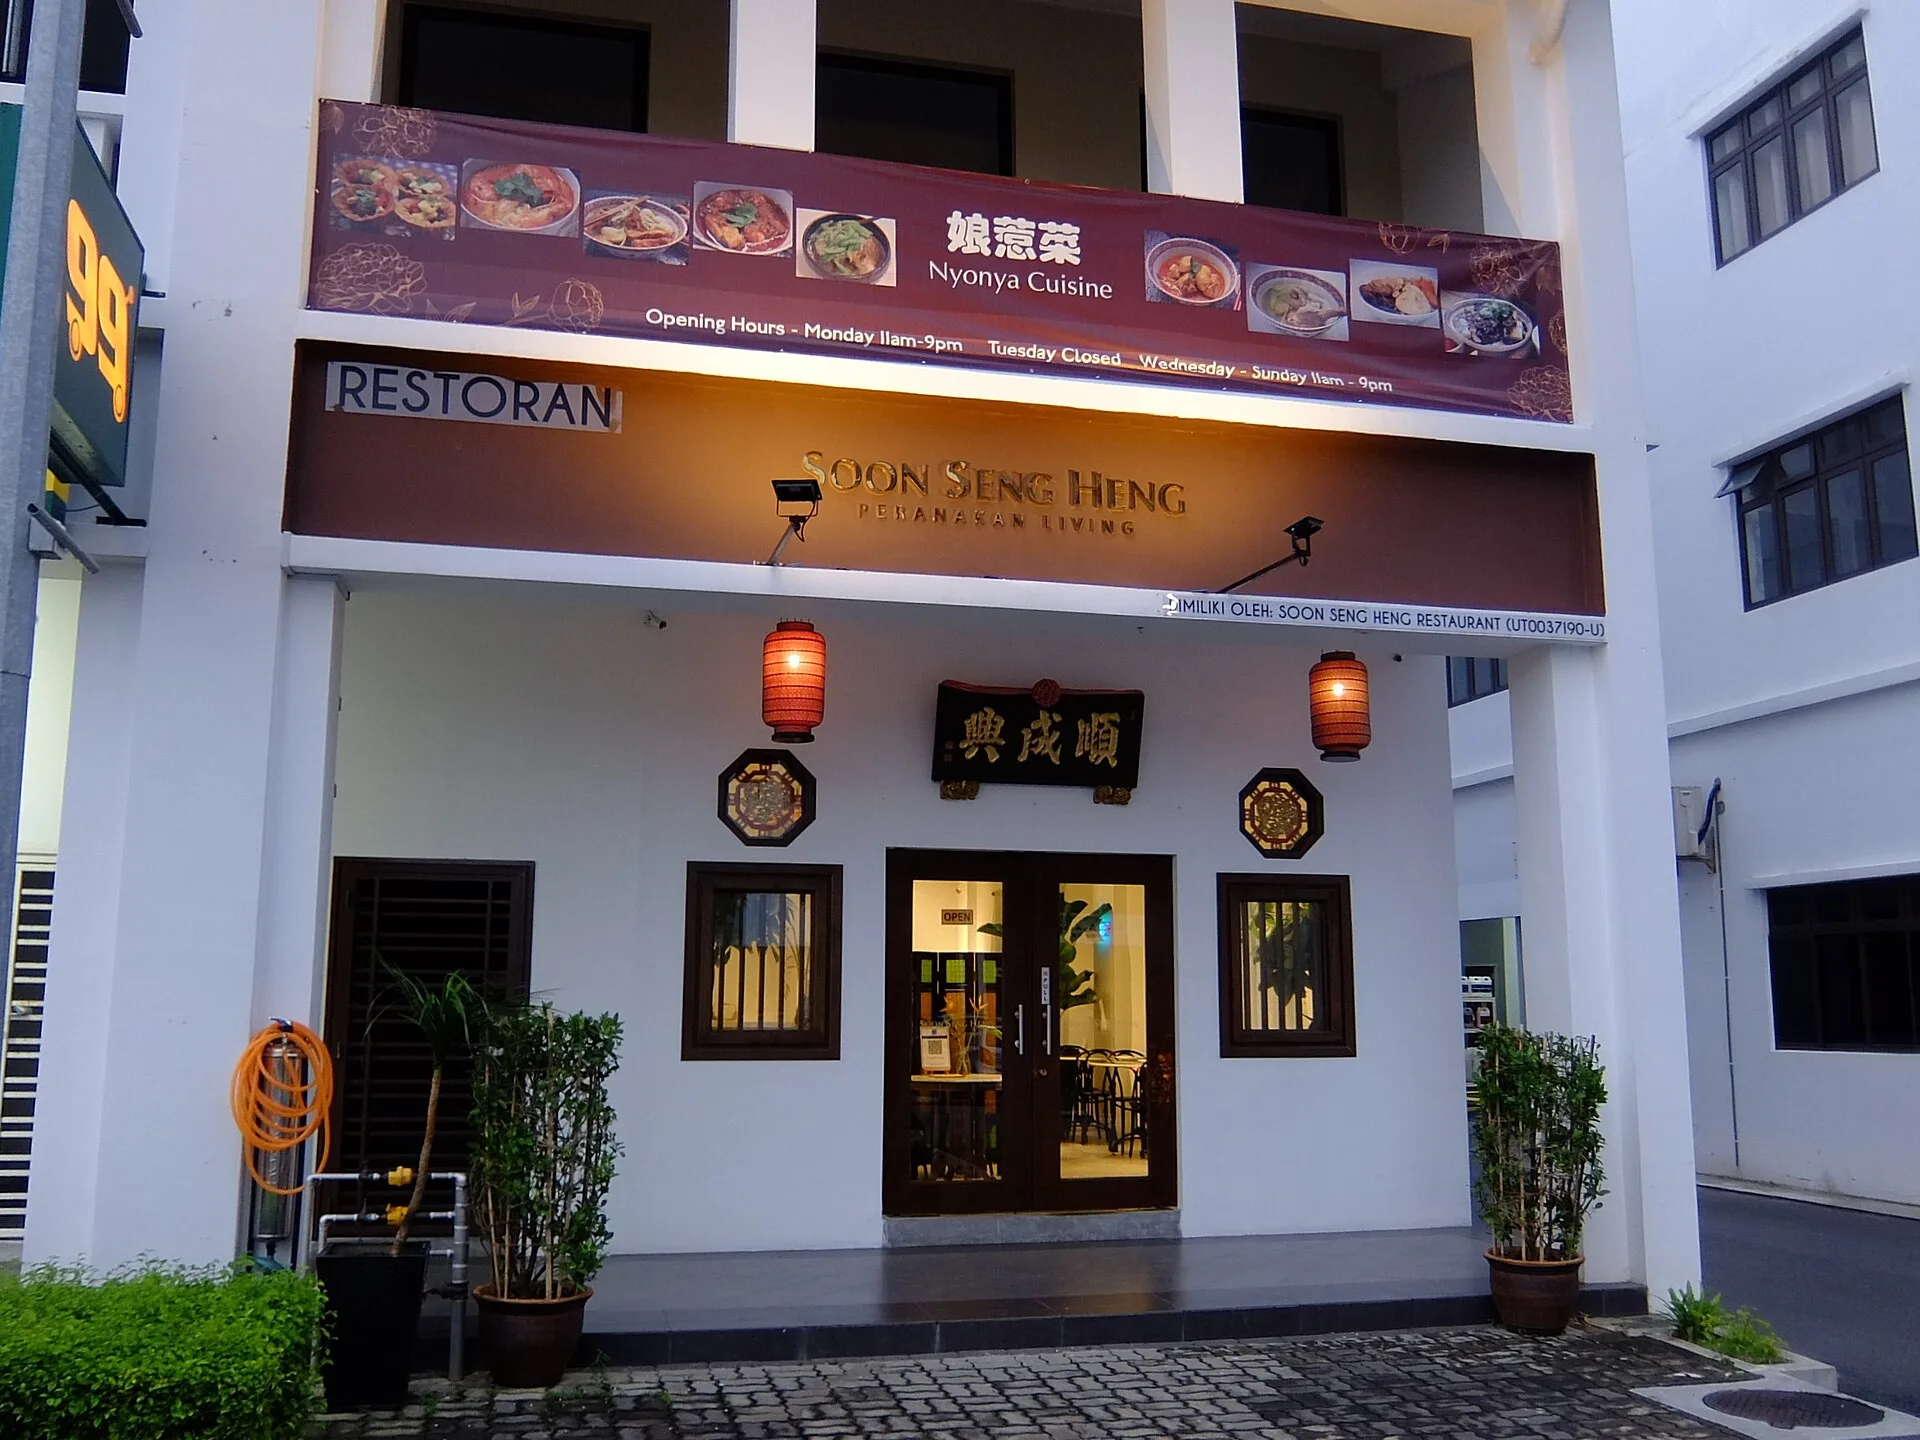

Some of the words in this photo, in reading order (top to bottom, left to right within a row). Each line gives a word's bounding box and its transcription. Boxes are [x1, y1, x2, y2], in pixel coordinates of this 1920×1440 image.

[946, 210, 1081, 266] 娘惹菜
[928, 260, 1020, 295] Nyonya
[1027, 271, 1113, 299] Cuisine
[64, 198, 131, 424] 99
[645, 308, 726, 335] Opening
[731, 316, 786, 336] Hours
[804, 322, 875, 347] Monday
[880, 330, 963, 354] 11am-9pm
[988, 340, 1056, 363] Tuesday
[1061, 347, 1122, 366] Closed
[1138, 353, 1235, 379] Wednesday
[1251, 365, 1307, 386] Sunday
[1311, 371, 1345, 386] 11am
[1358, 376, 1393, 393] 9pm
[339, 364, 612, 428] RESTORAN
[802, 450, 929, 497] SOON
[944, 460, 1054, 506] SENG
[1067, 469, 1186, 518] HENG
[858, 503, 1025, 529] PERANAKAN
[1042, 514, 1136, 536] LIVING
[1230, 602, 1273, 618] OLEH:
[1278, 604, 1324, 621] SOON
[1330, 607, 1367, 623] SENG
[1373, 610, 1411, 626] HENG
[1417, 612, 1501, 631] RESTAURANT
[1506, 617, 1605, 637] (UT0037190-U)
[943, 911, 971, 922] OPEN
